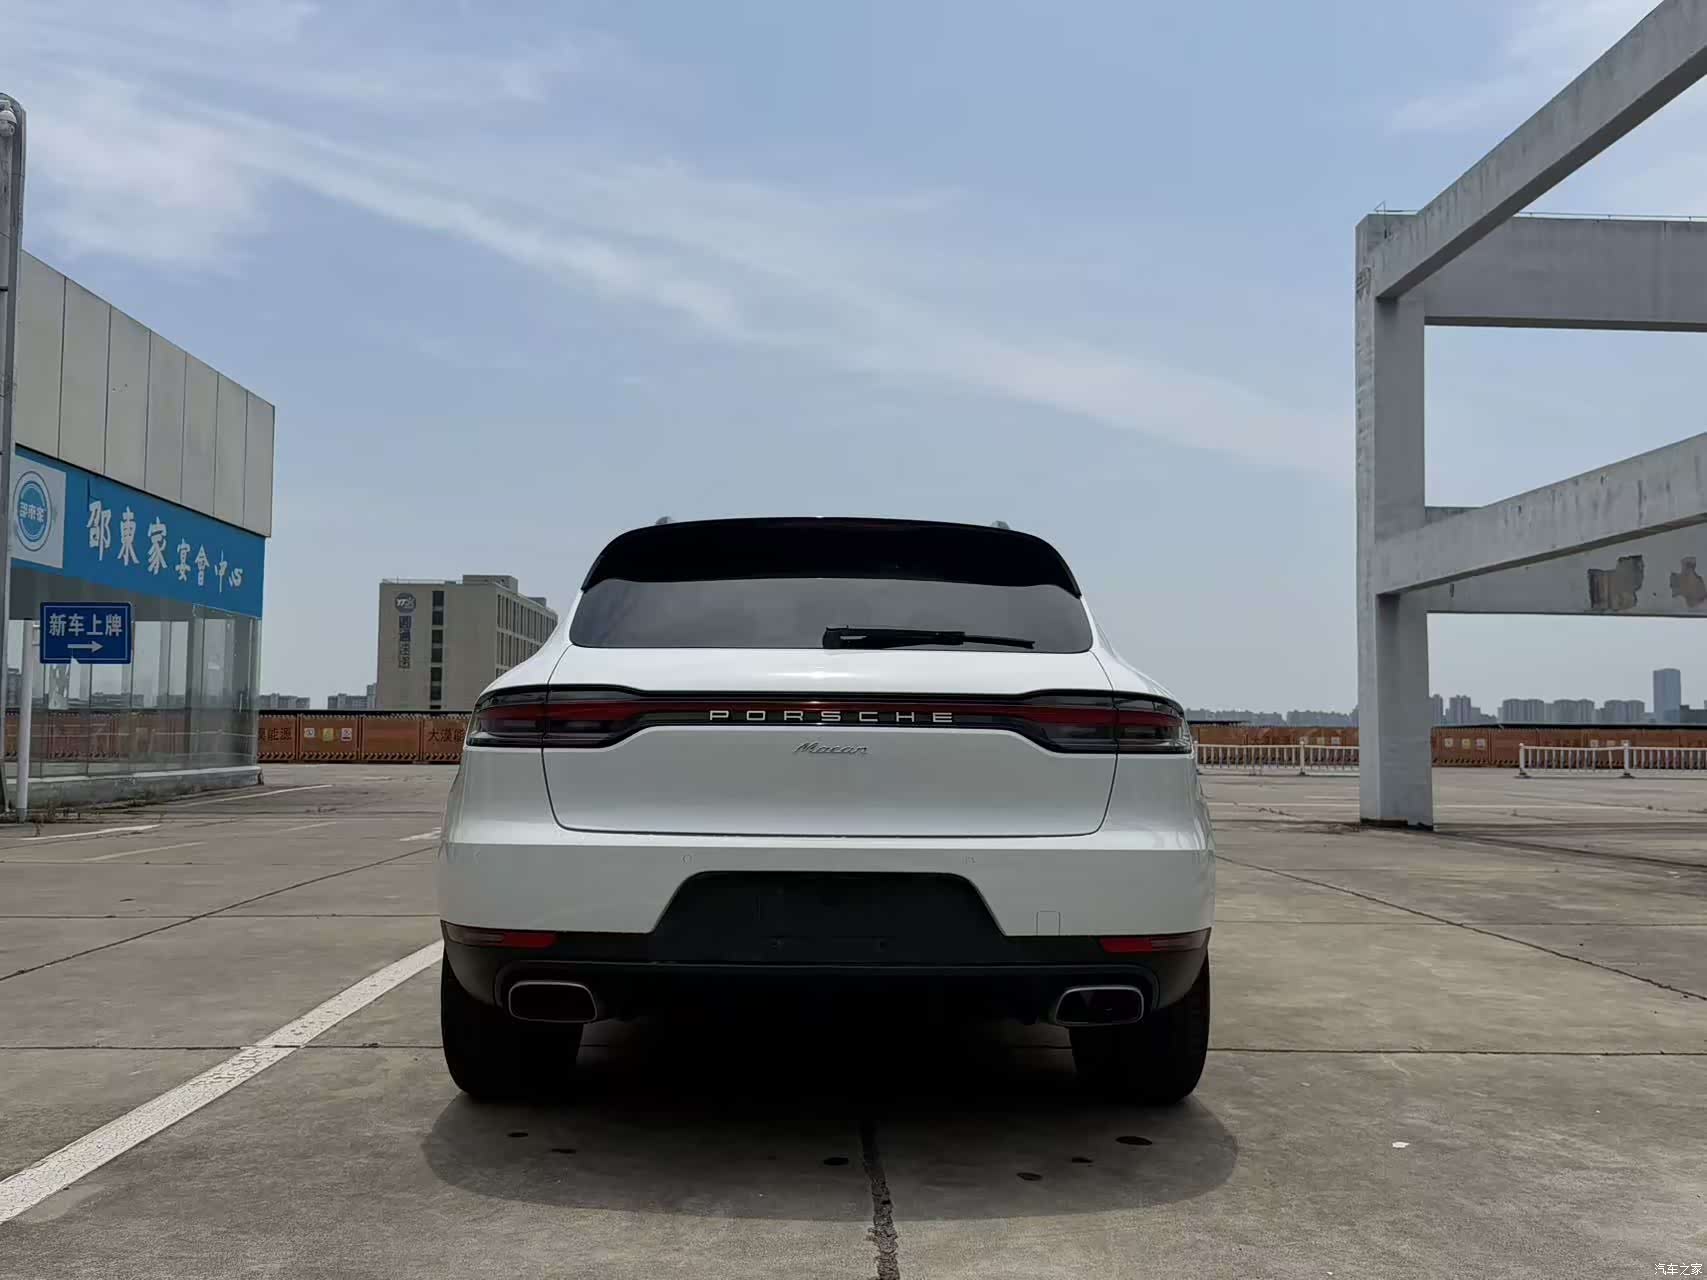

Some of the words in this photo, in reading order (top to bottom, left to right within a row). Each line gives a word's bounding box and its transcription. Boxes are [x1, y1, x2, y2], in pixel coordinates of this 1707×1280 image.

[48, 613, 123, 637] 新车上牌
[709, 710, 953, 723] PORSCHE
[793, 741, 869, 755] Macan
